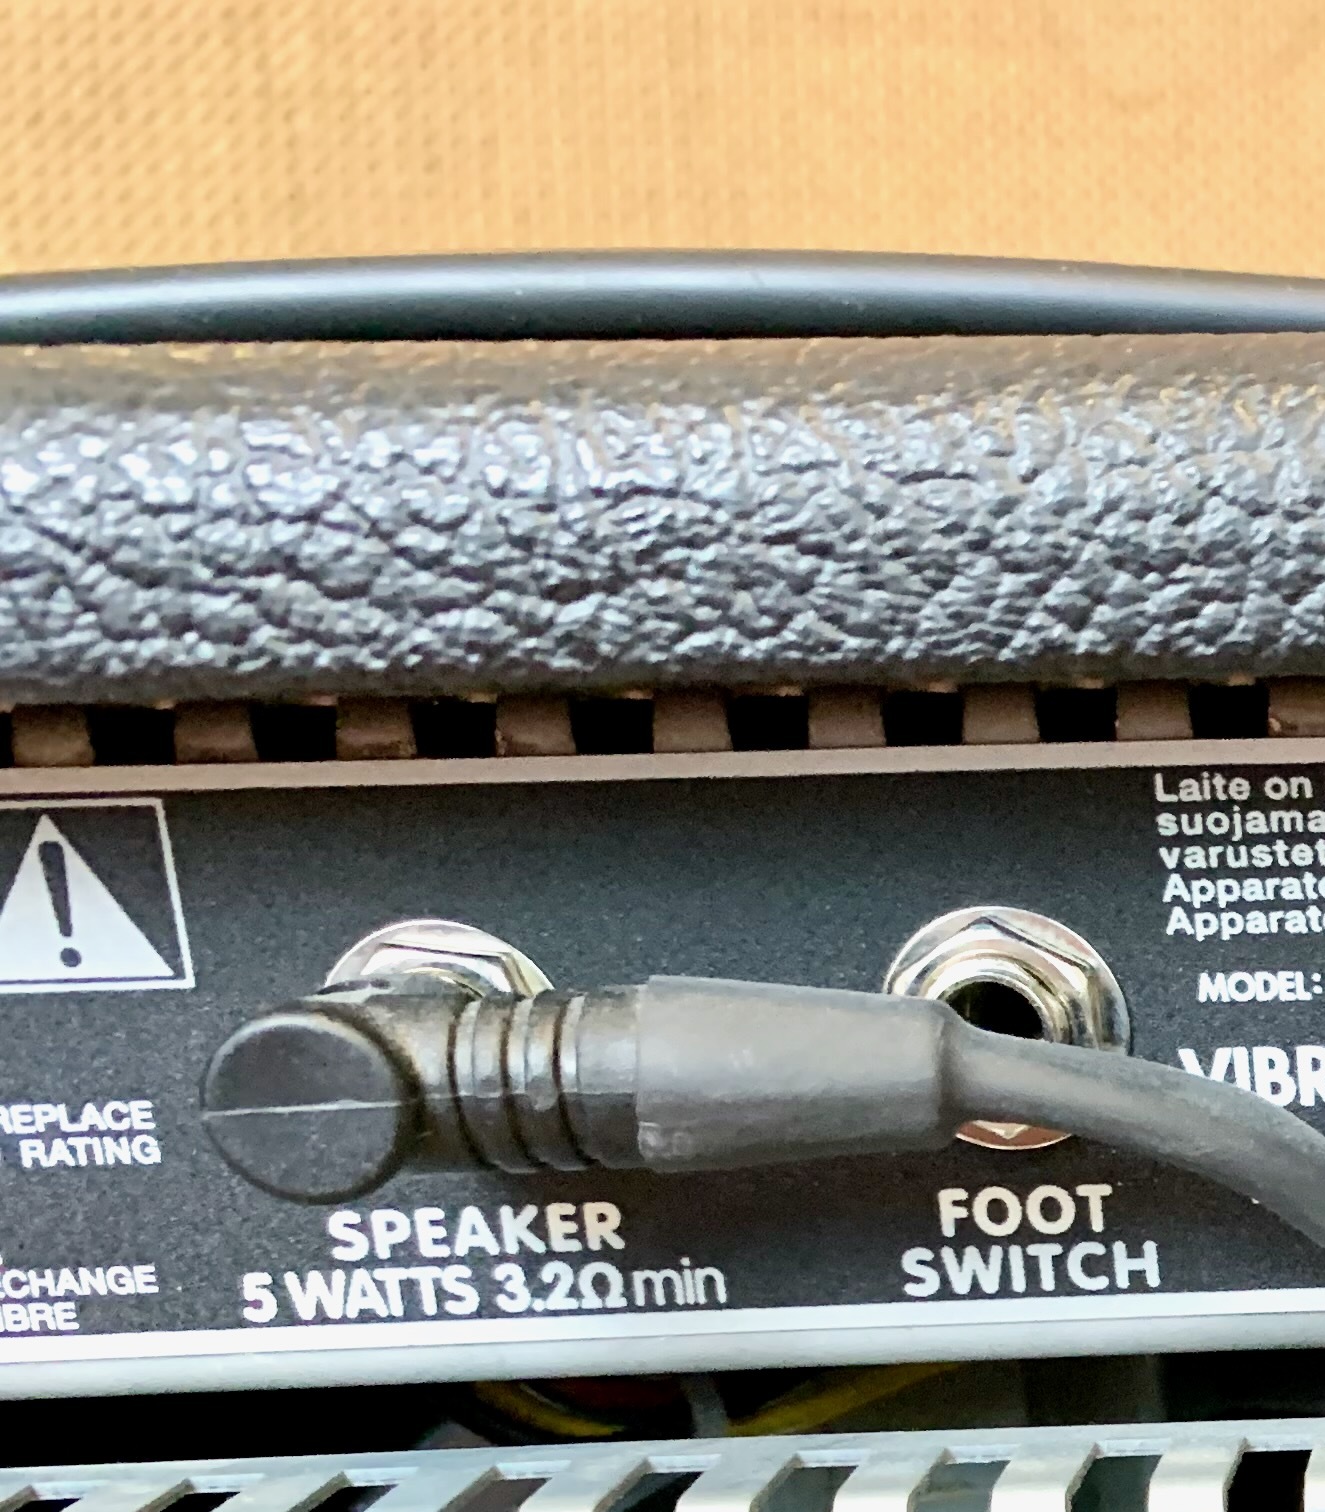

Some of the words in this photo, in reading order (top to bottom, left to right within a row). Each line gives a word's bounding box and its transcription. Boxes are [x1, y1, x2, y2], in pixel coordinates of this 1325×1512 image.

[1155, 772, 1250, 802] Laite
[1264, 776, 1312, 800] on
[1198, 971, 1322, 1002] MODEL:
[19, 1135, 161, 1168] RATING
[326, 1202, 625, 1261] SPEAKER
[938, 1184, 1112, 1237] FOOT
[0, 1264, 159, 1299] CHANGE
[902, 1241, 1160, 1297] SWITCH
[243, 1272, 278, 1323] 5
[284, 1265, 480, 1320] WATTS
